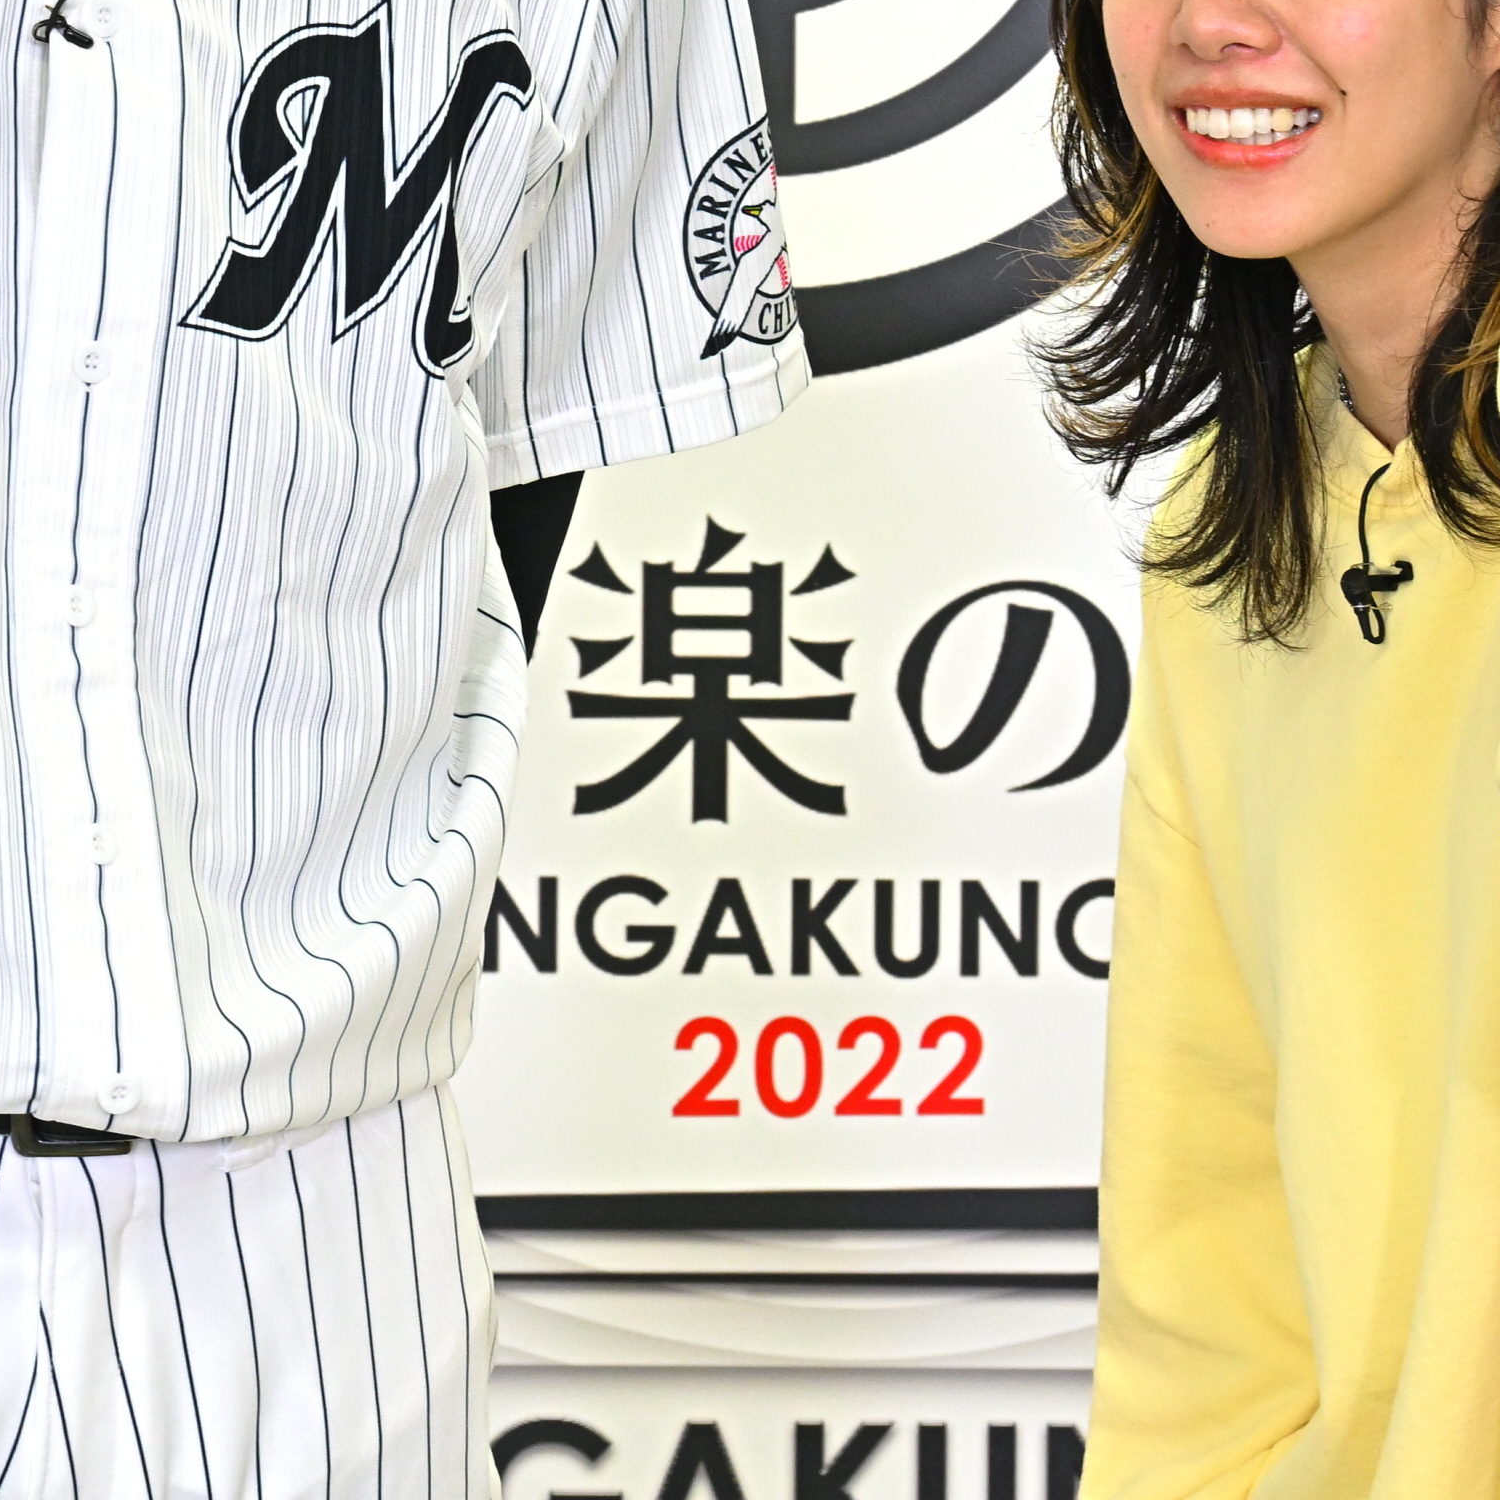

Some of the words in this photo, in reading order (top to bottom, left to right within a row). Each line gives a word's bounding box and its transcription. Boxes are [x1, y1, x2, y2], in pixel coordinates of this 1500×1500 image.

[693, 126, 773, 281] MARINE
[758, 290, 797, 335] CHI
[566, 514, 1132, 824] 楽の
[672, 1015, 985, 1118] 2022
